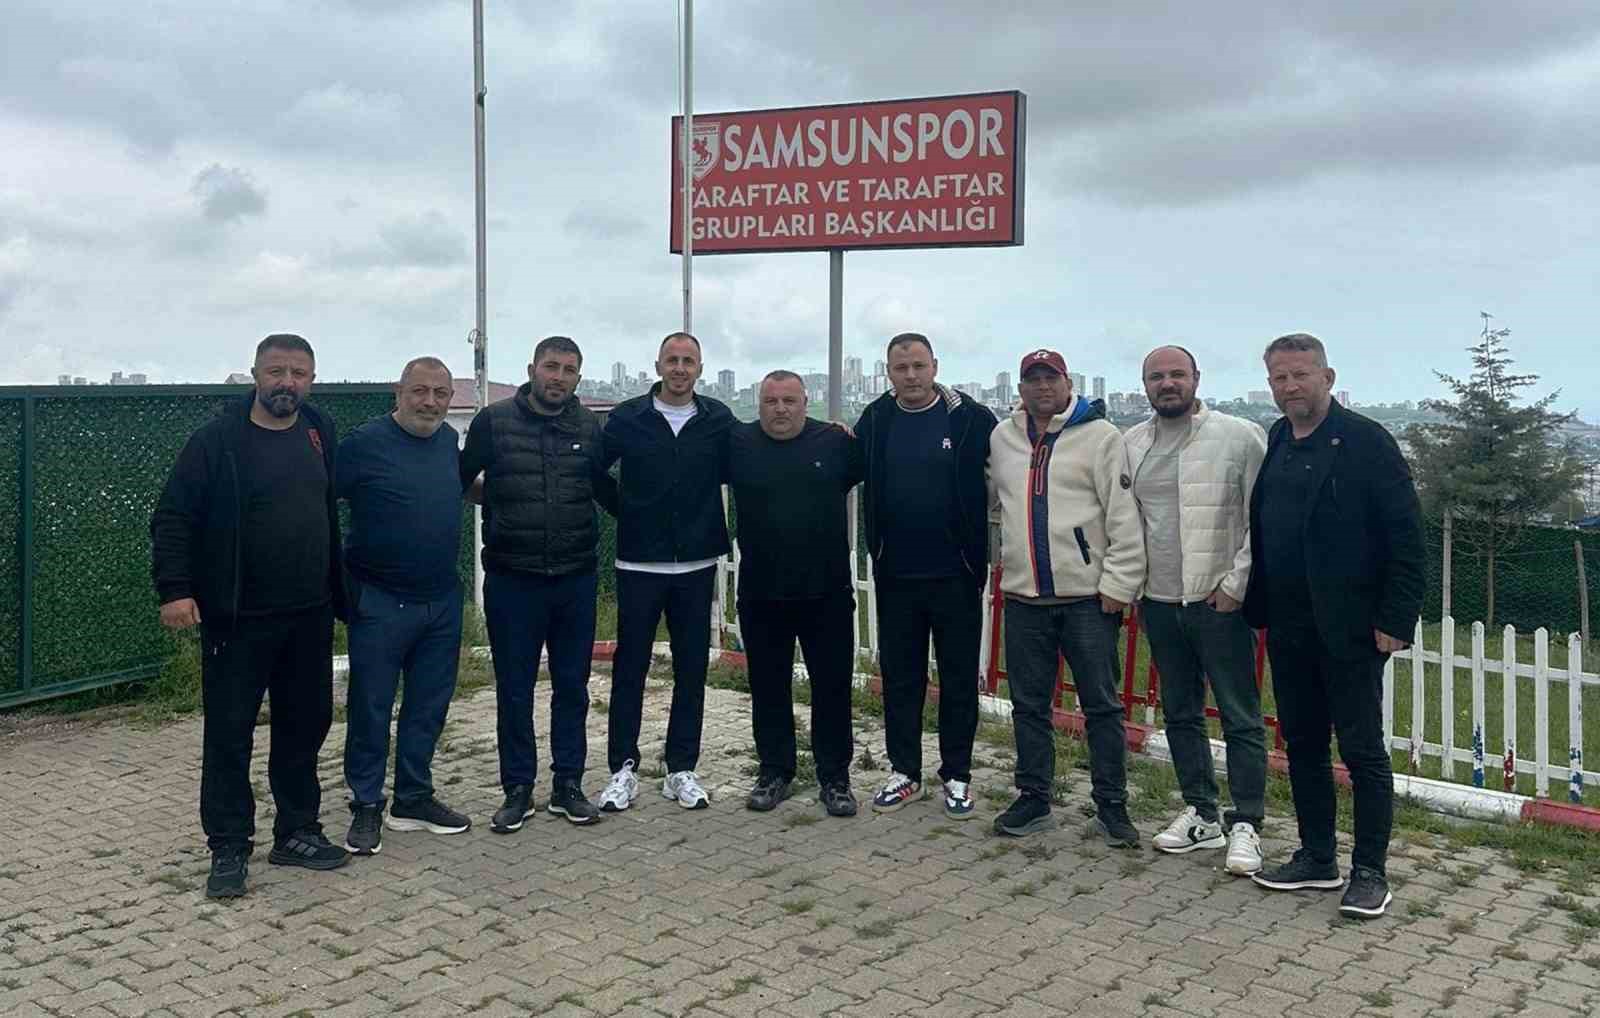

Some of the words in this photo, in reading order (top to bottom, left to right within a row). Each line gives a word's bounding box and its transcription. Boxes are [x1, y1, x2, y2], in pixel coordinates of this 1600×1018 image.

[724, 108, 1005, 172] SAMSUNSPOR
[817, 180, 849, 203] VE
[859, 172, 1005, 202] TARAFTAR
[691, 214, 815, 240] GRUPLARI
[825, 200, 996, 238] BAŞKANLIĞI
